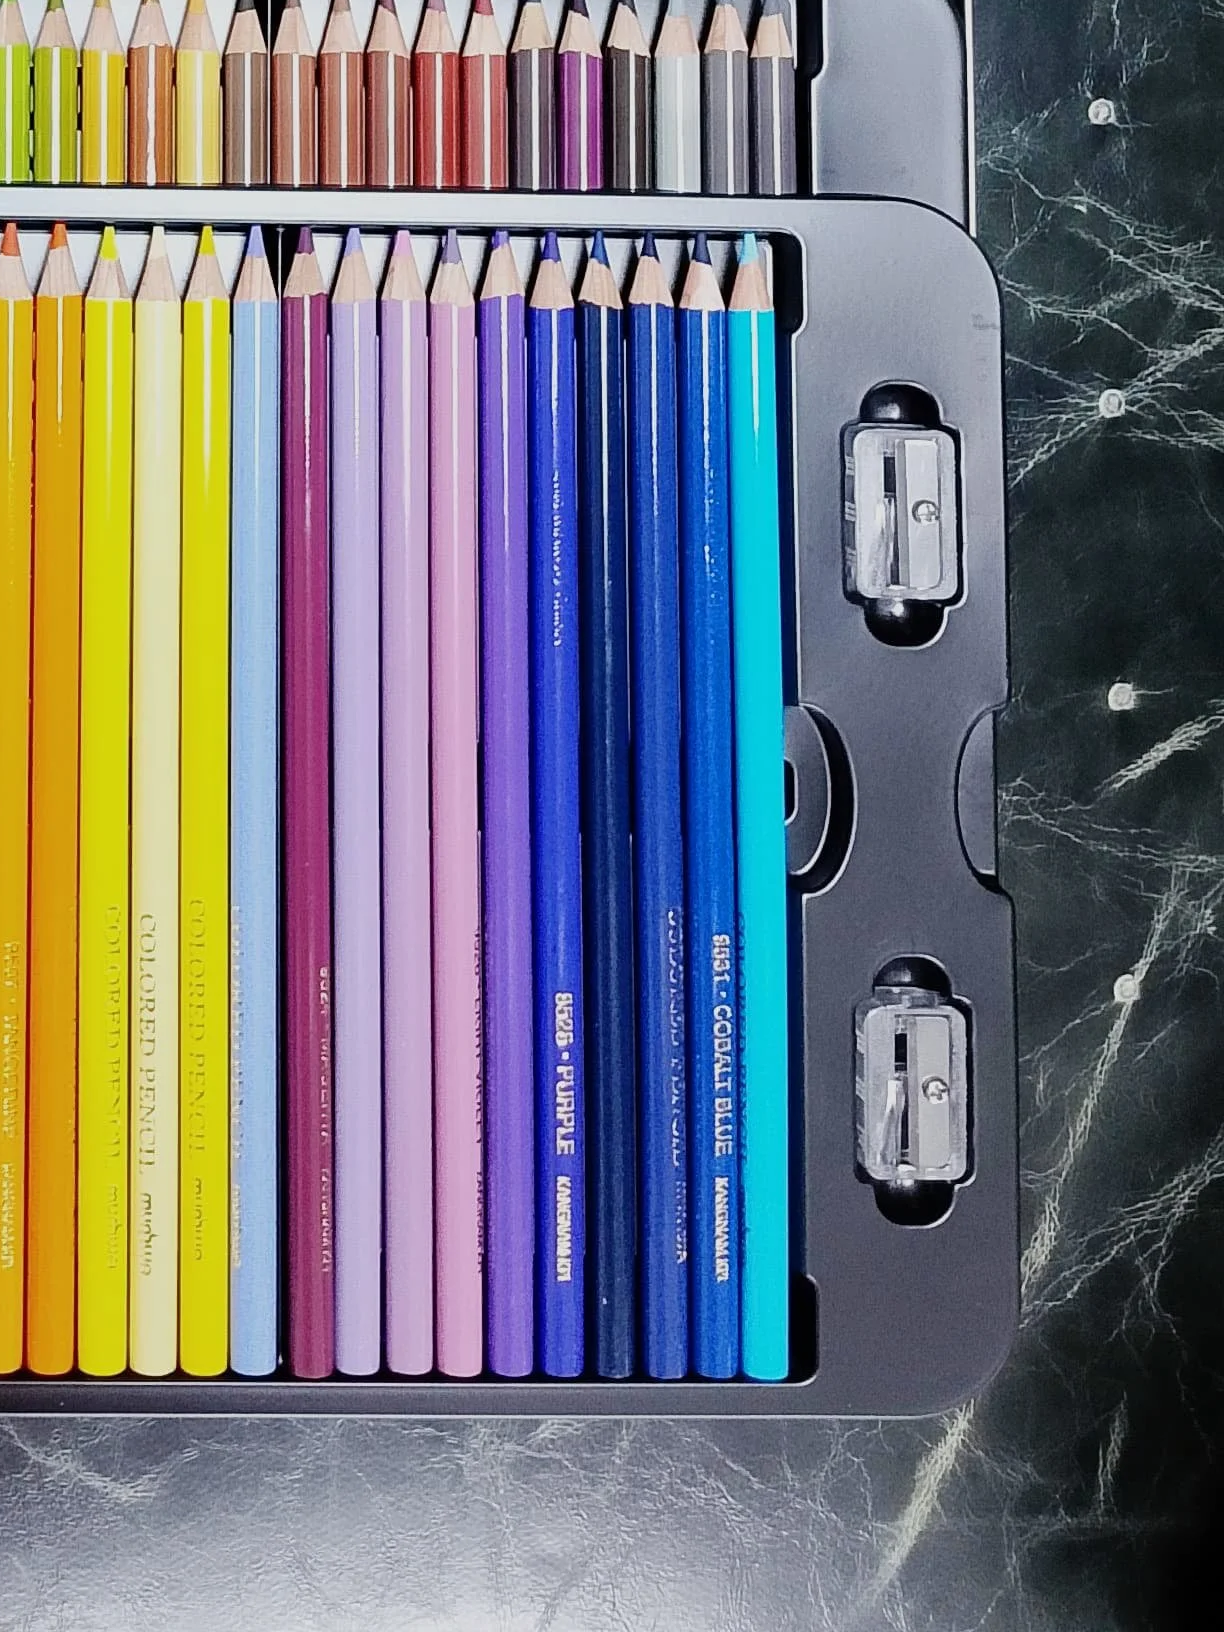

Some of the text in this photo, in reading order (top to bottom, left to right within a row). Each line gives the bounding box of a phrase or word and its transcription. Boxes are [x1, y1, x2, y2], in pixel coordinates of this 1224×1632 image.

[139, 914, 156, 1057] COLORED
[189, 899, 206, 1041] COLORED
[713, 1004, 732, 1091] COBALT
[138, 1067, 156, 1175] PENCIL
[188, 1051, 205, 1161] PENCIL
[555, 1065, 575, 1155] PURPLE
[714, 1097, 732, 1157] BLUE
